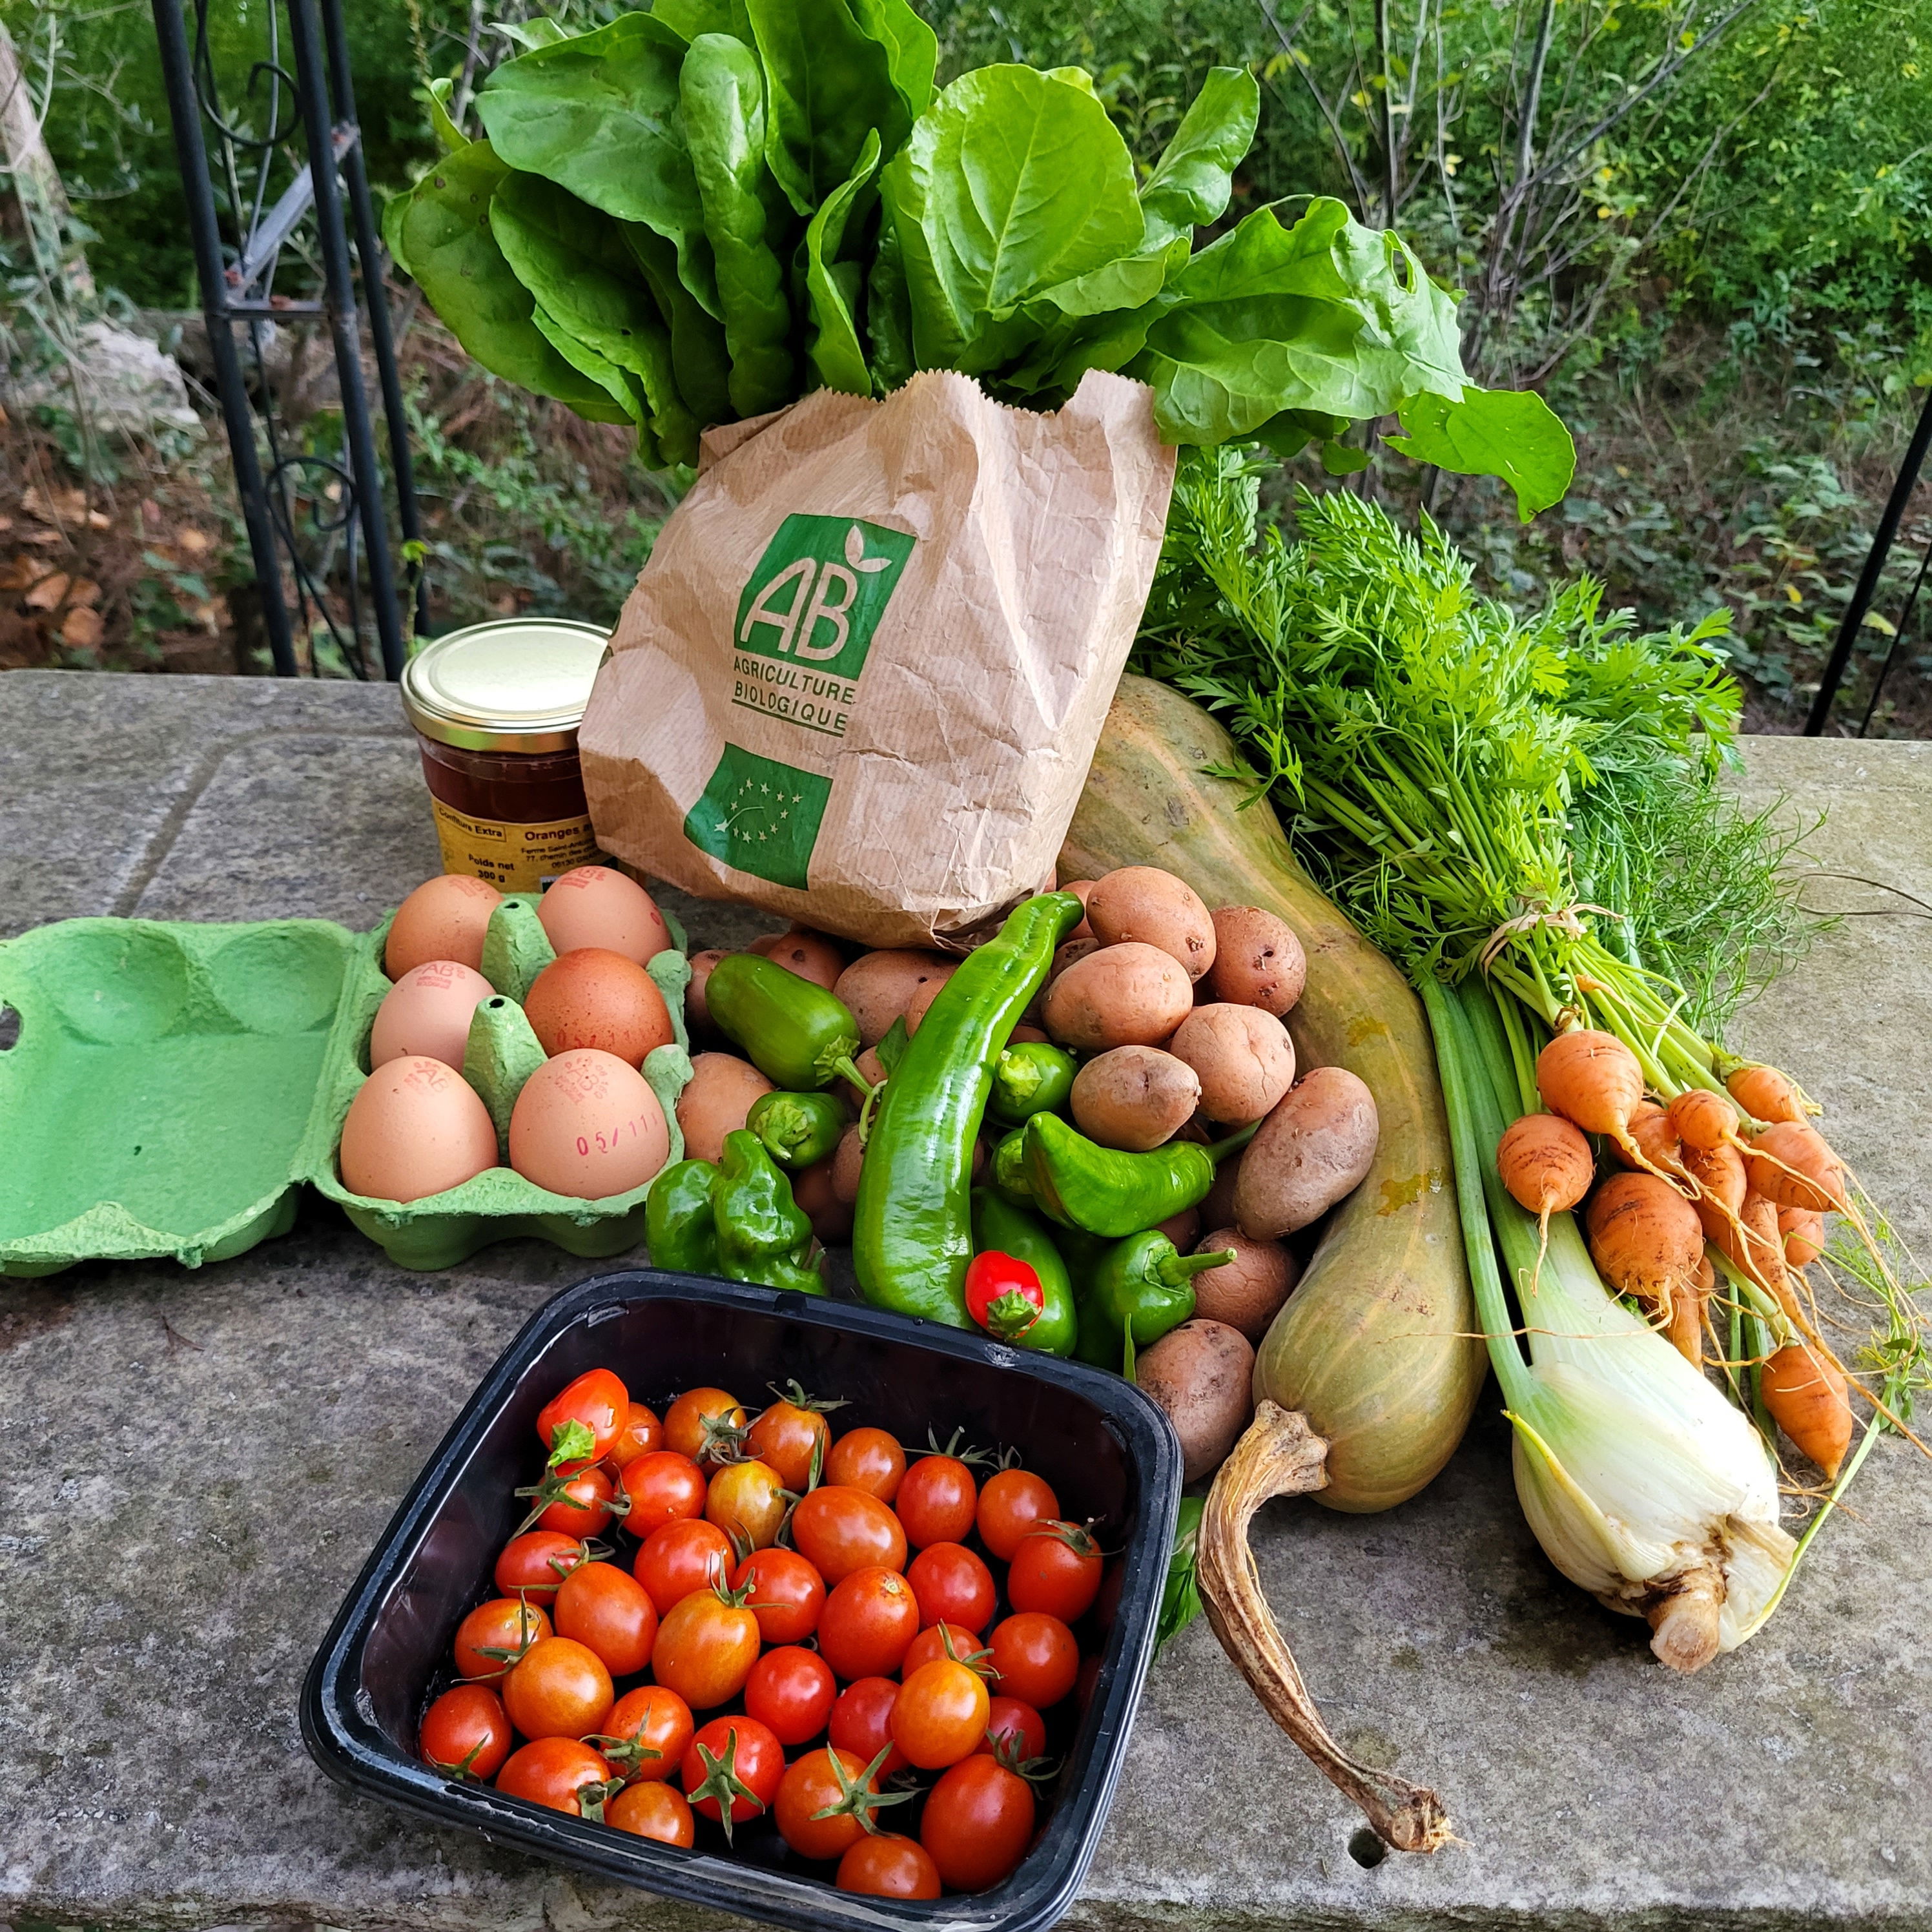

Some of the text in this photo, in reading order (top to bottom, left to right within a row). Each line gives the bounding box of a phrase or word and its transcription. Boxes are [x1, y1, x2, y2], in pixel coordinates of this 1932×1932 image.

[740, 557, 858, 661] AB
[734, 655, 856, 705] AGRICULTURE
[734, 680, 848, 732] BIOLOGIQUE
[439, 807, 502, 838] Confiture Extra
[525, 827, 579, 841] Oranges
[468, 853, 495, 868] Poids
[477, 870, 495, 879] 300
